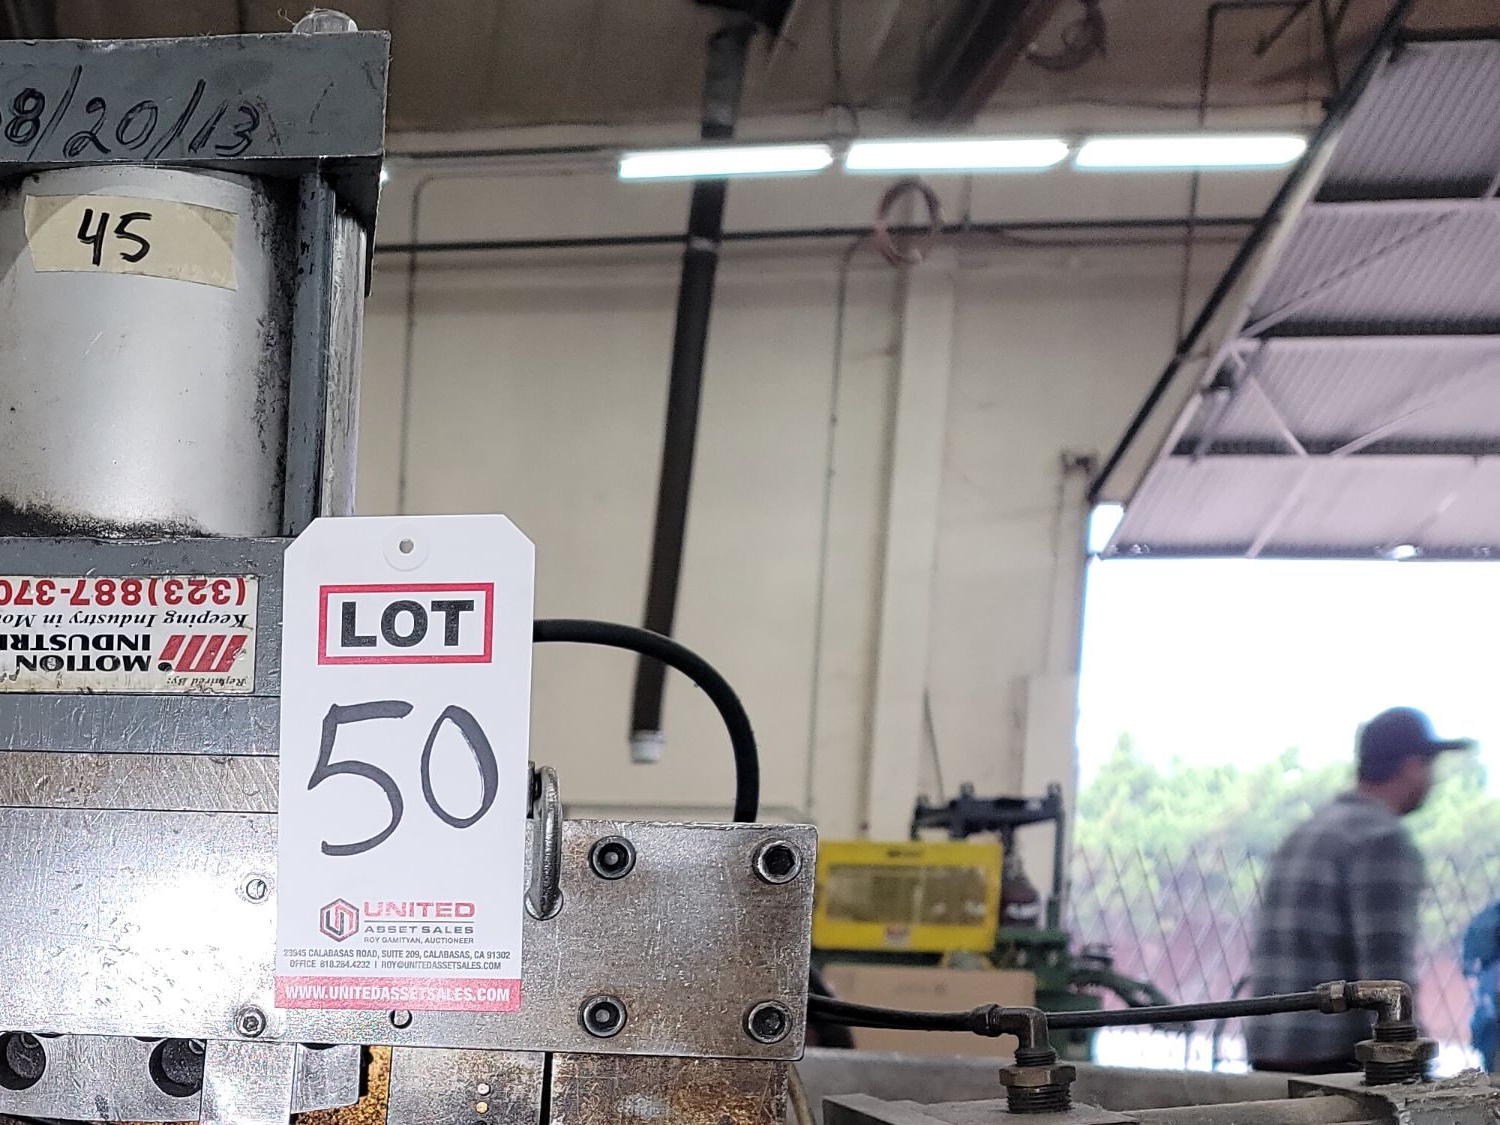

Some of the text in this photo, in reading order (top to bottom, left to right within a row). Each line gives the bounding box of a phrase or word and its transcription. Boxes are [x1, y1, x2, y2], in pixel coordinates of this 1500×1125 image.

[77, 208, 152, 267] 45
[43, 614, 64, 628] in
[69, 611, 158, 628] Industry
[163, 610, 249, 628] Keeping
[341, 599, 475, 648] LOT
[16, 655, 152, 672] MOTION
[307, 699, 499, 857] 50
[363, 901, 476, 918] UNITED
[364, 925, 474, 934] ASSET SALES
[363, 936, 380, 944] ROY
[424, 937, 474, 945] AUCTIONEER
[308, 949, 354, 958] CALABASAS
[356, 950, 380, 960] ROAD,
[381, 950, 404, 958] SUITE
[405, 951, 422, 960] 209,
[423, 950, 473, 961] CALABASAS,
[474, 951, 485, 960] CA
[486, 951, 511, 960] 91302
[289, 960, 317, 968] OFFICE
